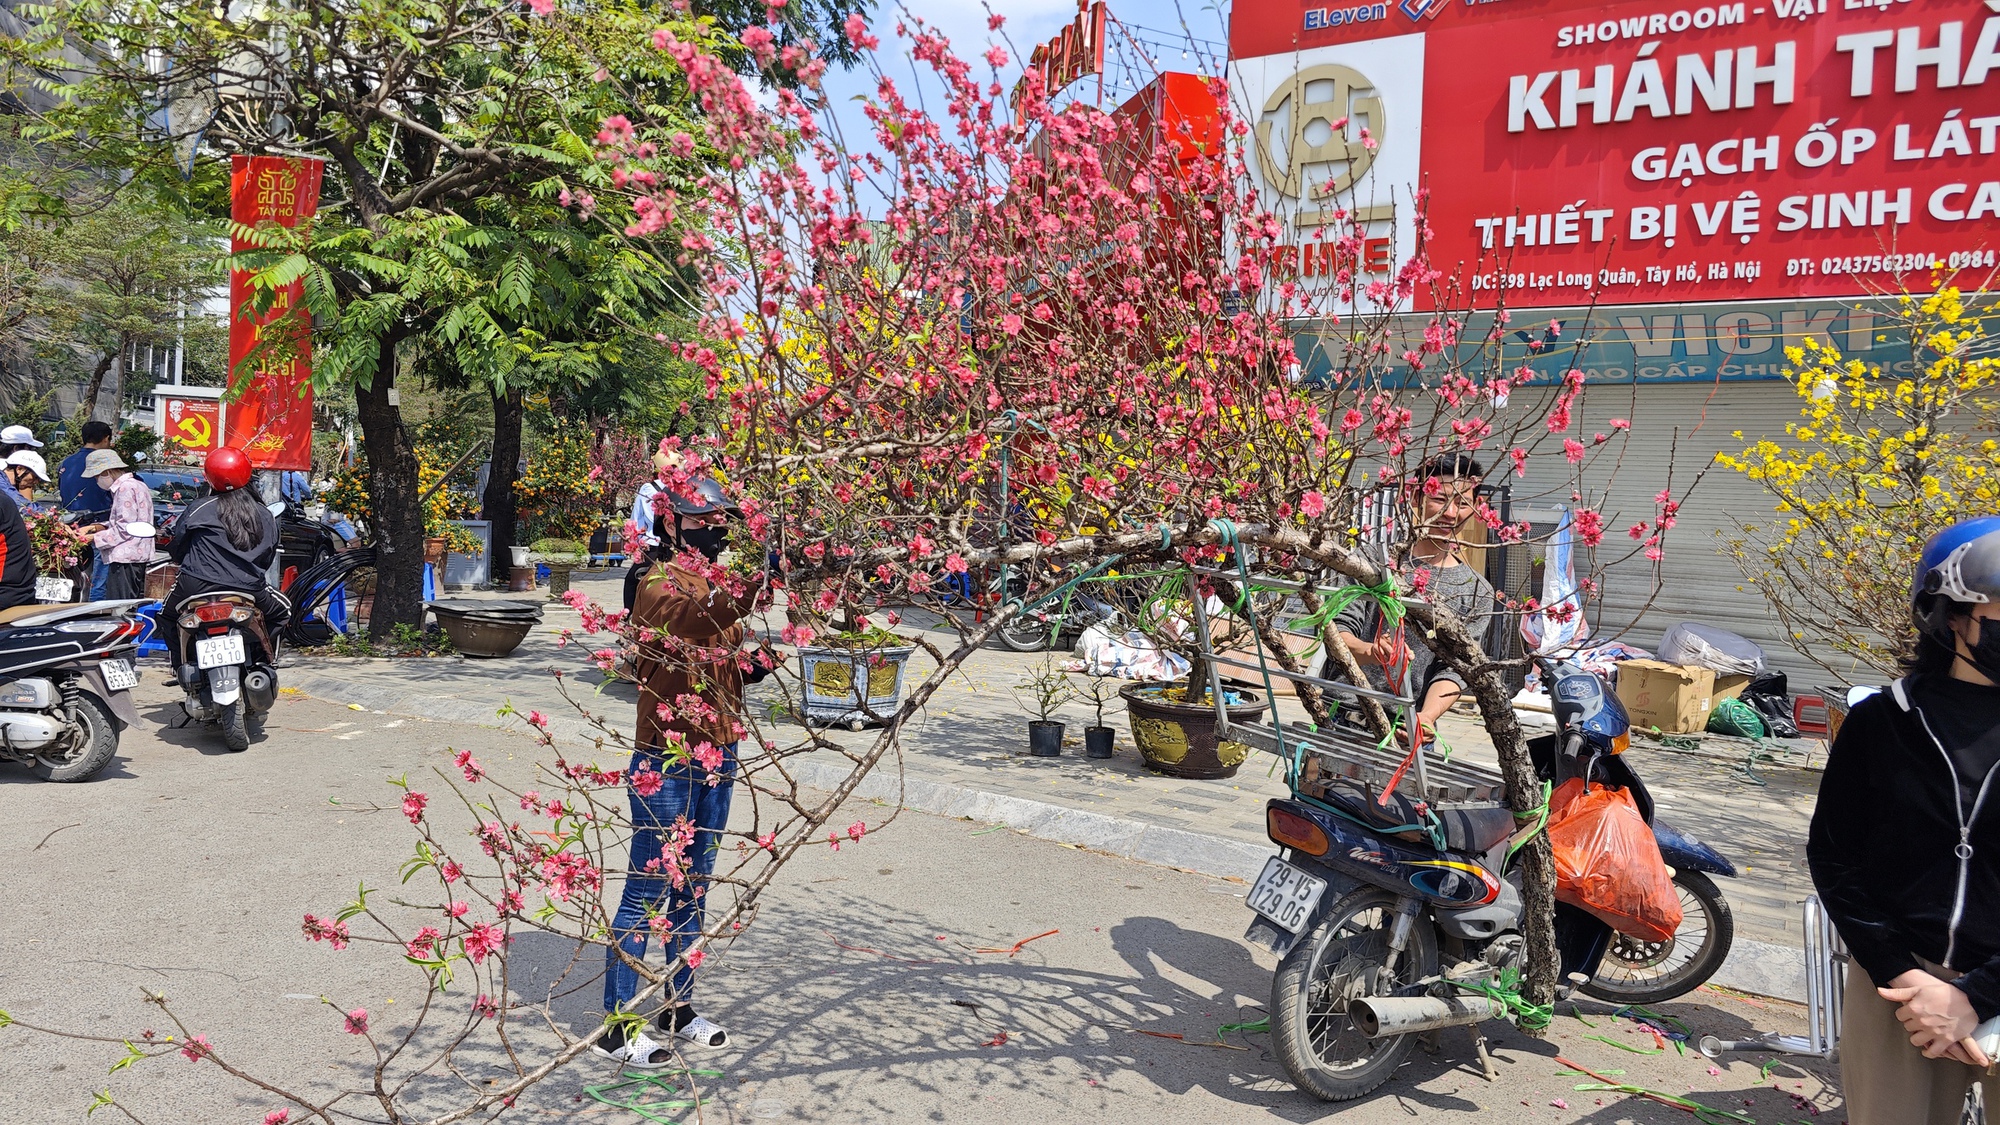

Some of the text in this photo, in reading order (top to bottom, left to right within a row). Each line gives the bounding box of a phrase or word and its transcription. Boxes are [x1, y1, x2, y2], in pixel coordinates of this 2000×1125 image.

[1557, 3, 1744, 47] SHOWROOM
[1507, 40, 1796, 132] KHÁNH
[1632, 108, 2000, 188] GẠCH ỐP LÁT
[258, 205, 278, 216] TÂY
[1475, 181, 2000, 249] THIẾT BỊ VỆ SINH CA
[1247, 238, 1391, 278] RIME
[1529, 272, 1553, 291] Lạc
[1557, 270, 1592, 290] Long
[1599, 268, 1641, 288] Quân,
[1646, 266, 1671, 287] Tây
[1676, 261, 1702, 284] Hồ,
[1708, 262, 1729, 280] Hà
[1734, 261, 1761, 283] Nội
[1787, 258, 1815, 276] ĐT:
[1616, 308, 1876, 357] VICKI
[1638, 361, 1706, 378] CẤP
[9, 631, 56, 639] LEAD
[204, 639, 236, 654] 29-L5
[202, 650, 242, 666] 419.10
[1629, 707, 1657, 716] TONGXIN
[1267, 863, 1316, 901] 29-V5
[1253, 885, 1306, 927] 129.06
